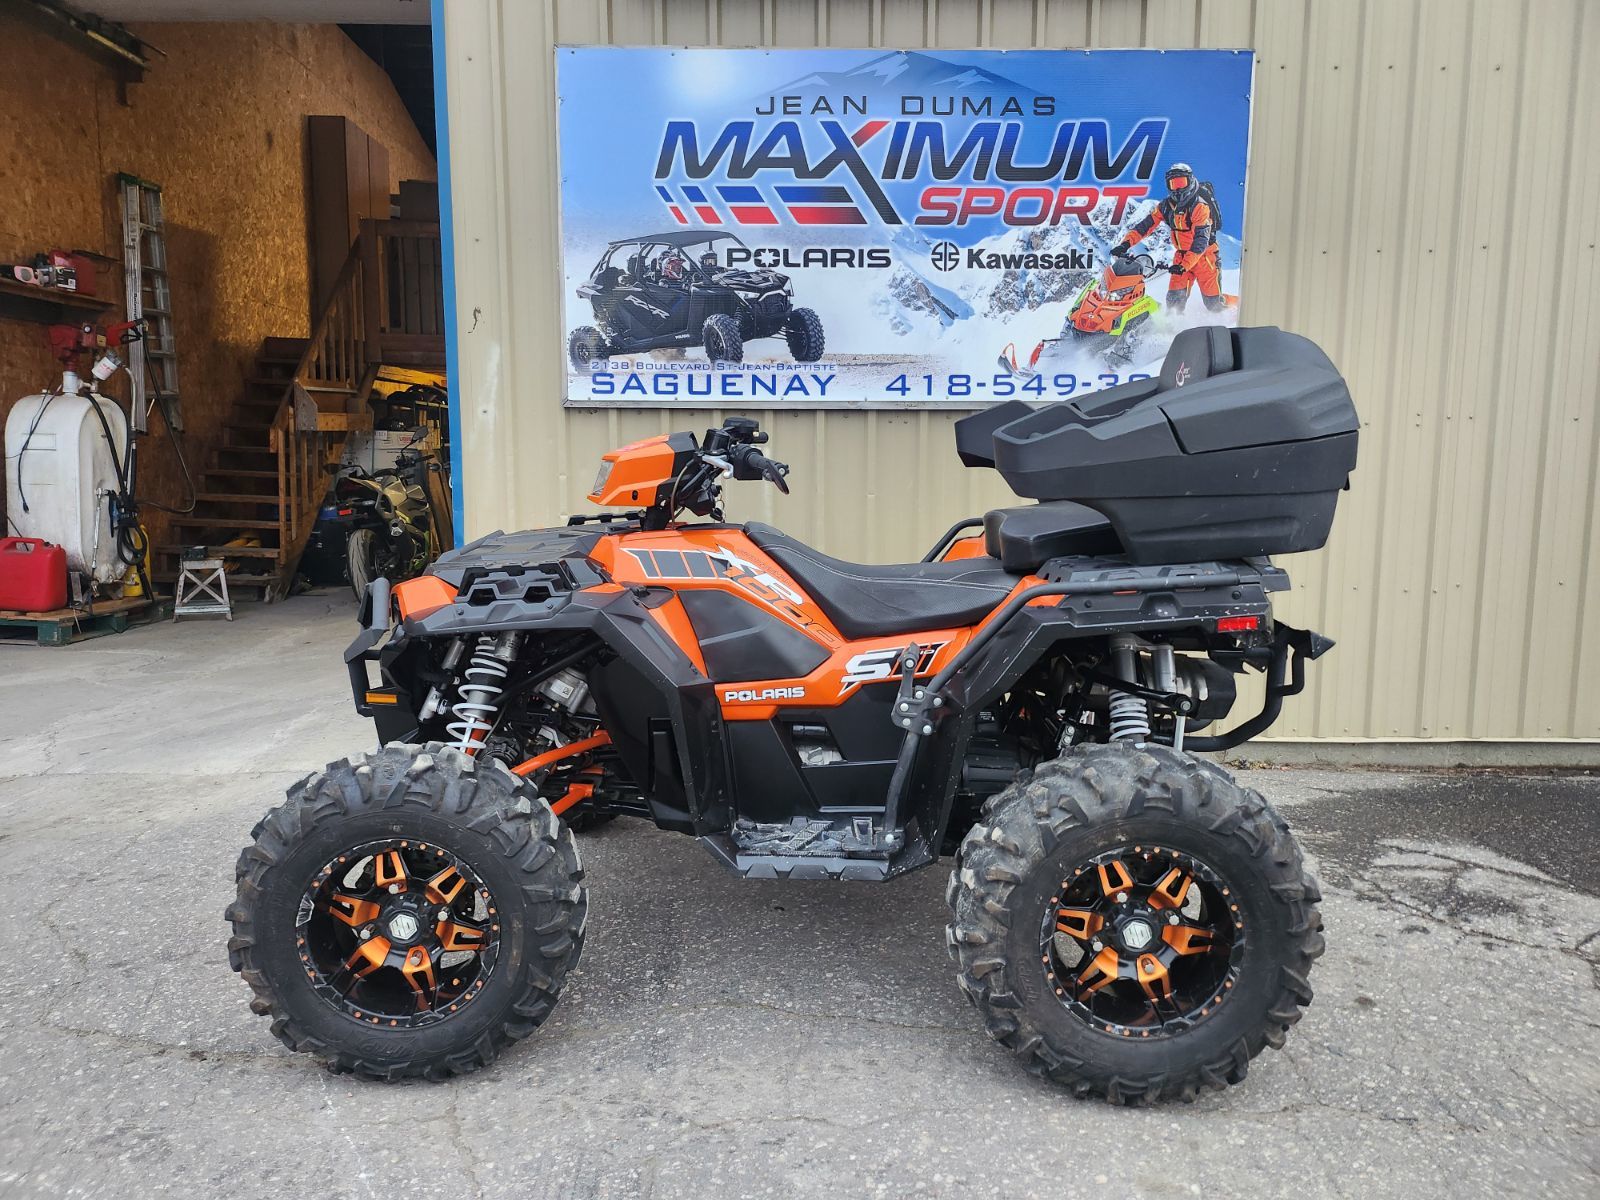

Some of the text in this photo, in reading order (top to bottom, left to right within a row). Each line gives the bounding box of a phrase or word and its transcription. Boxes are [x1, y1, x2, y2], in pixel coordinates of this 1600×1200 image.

[755, 95, 1056, 116] JEAN DUMAS
[654, 120, 1168, 224] MAXIMUM
[914, 186, 1149, 226] SPORT
[726, 248, 892, 268] POLARIS
[967, 248, 1094, 270] Kawasaki
[591, 361, 629, 370] 2138
[591, 372, 836, 396] SAGUENAY
[702, 545, 803, 605] XP
[724, 686, 805, 703] POLARIS
